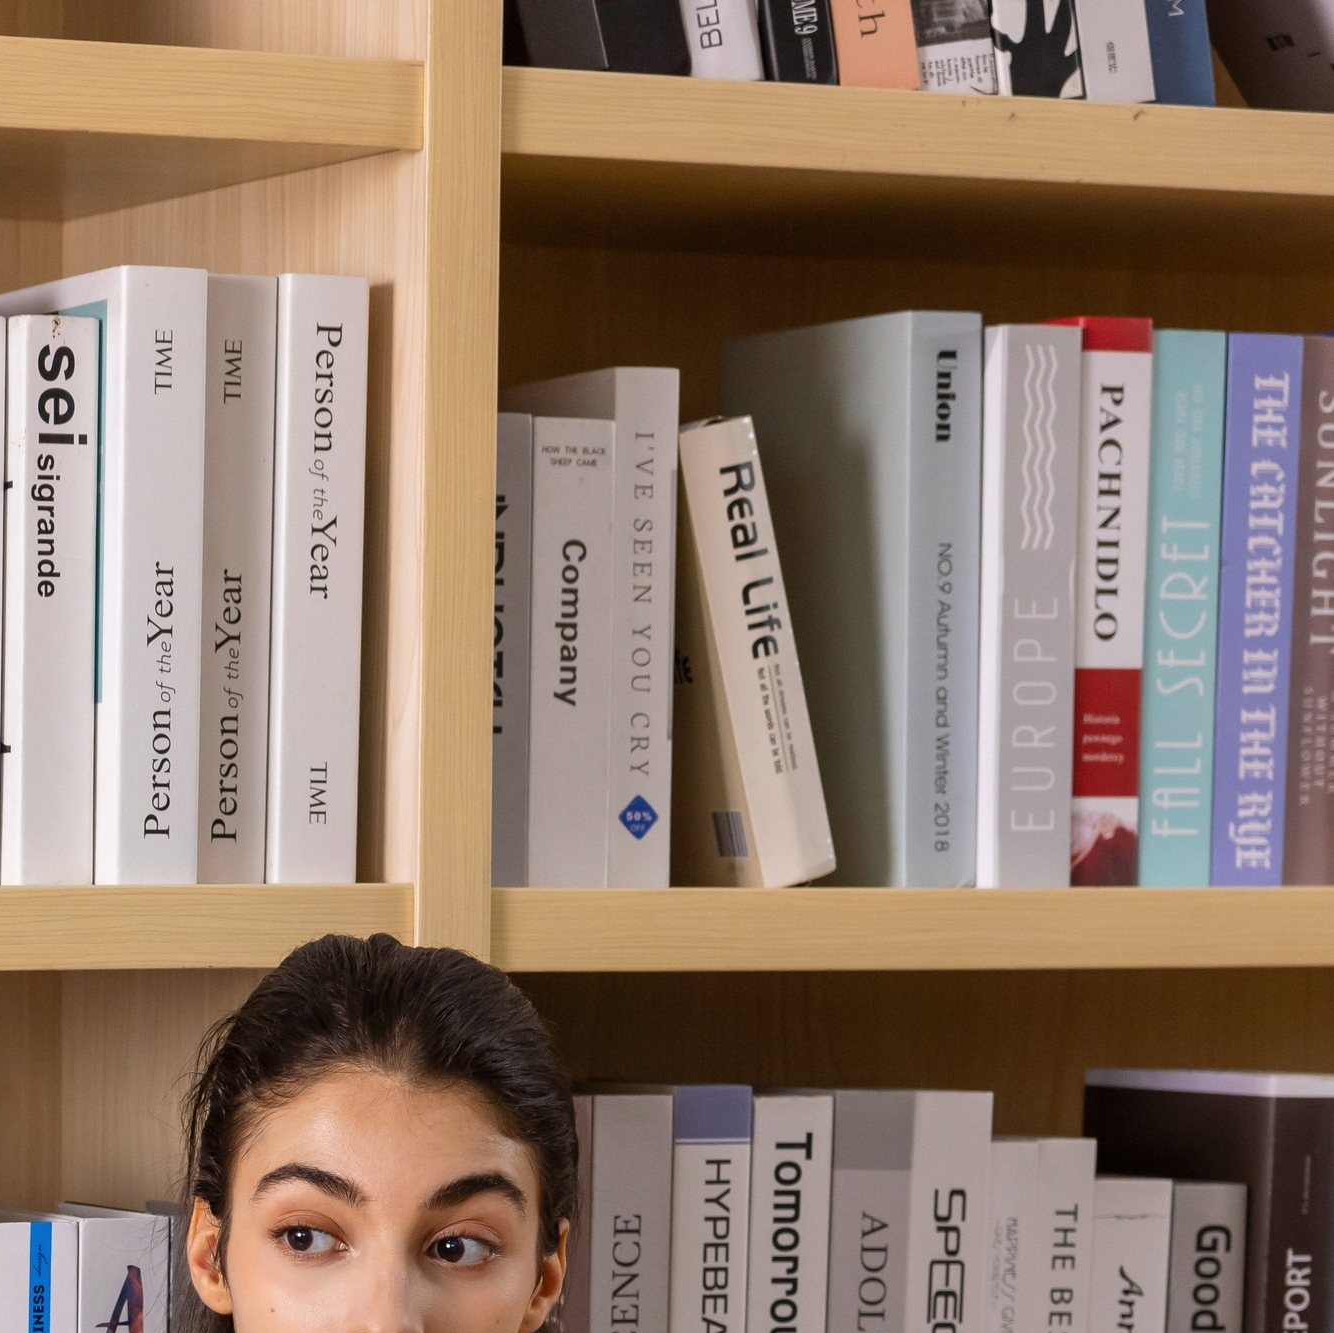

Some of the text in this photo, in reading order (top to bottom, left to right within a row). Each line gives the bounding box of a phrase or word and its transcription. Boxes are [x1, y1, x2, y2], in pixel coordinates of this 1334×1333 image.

[155, 330, 172, 394] TIME
[936, 350, 957, 442] Union
[1252, 372, 1290, 448] THE
[31, 454, 60, 597] sigrande
[720, 461, 781, 659] Real Life
[1094, 385, 1124, 641] PACHNIDLO
[1244, 459, 1285, 637] CATCHER
[554, 539, 587, 706] Company
[630, 432, 654, 775] I'VE SEEN YOU CRY
[1156, 516, 1211, 697] SECRET
[144, 562, 176, 838] Person of the Year
[934, 542, 953, 852] NO.9 Autumn and Winter 2018
[1010, 597, 1058, 832] EUROPE
[1239, 705, 1276, 780] THE
[626, 811, 652, 821] 50%
[1151, 733, 1203, 838] FALL
[1051, 1204, 1078, 1270] THE
[1191, 1225, 1232, 1332] Good
